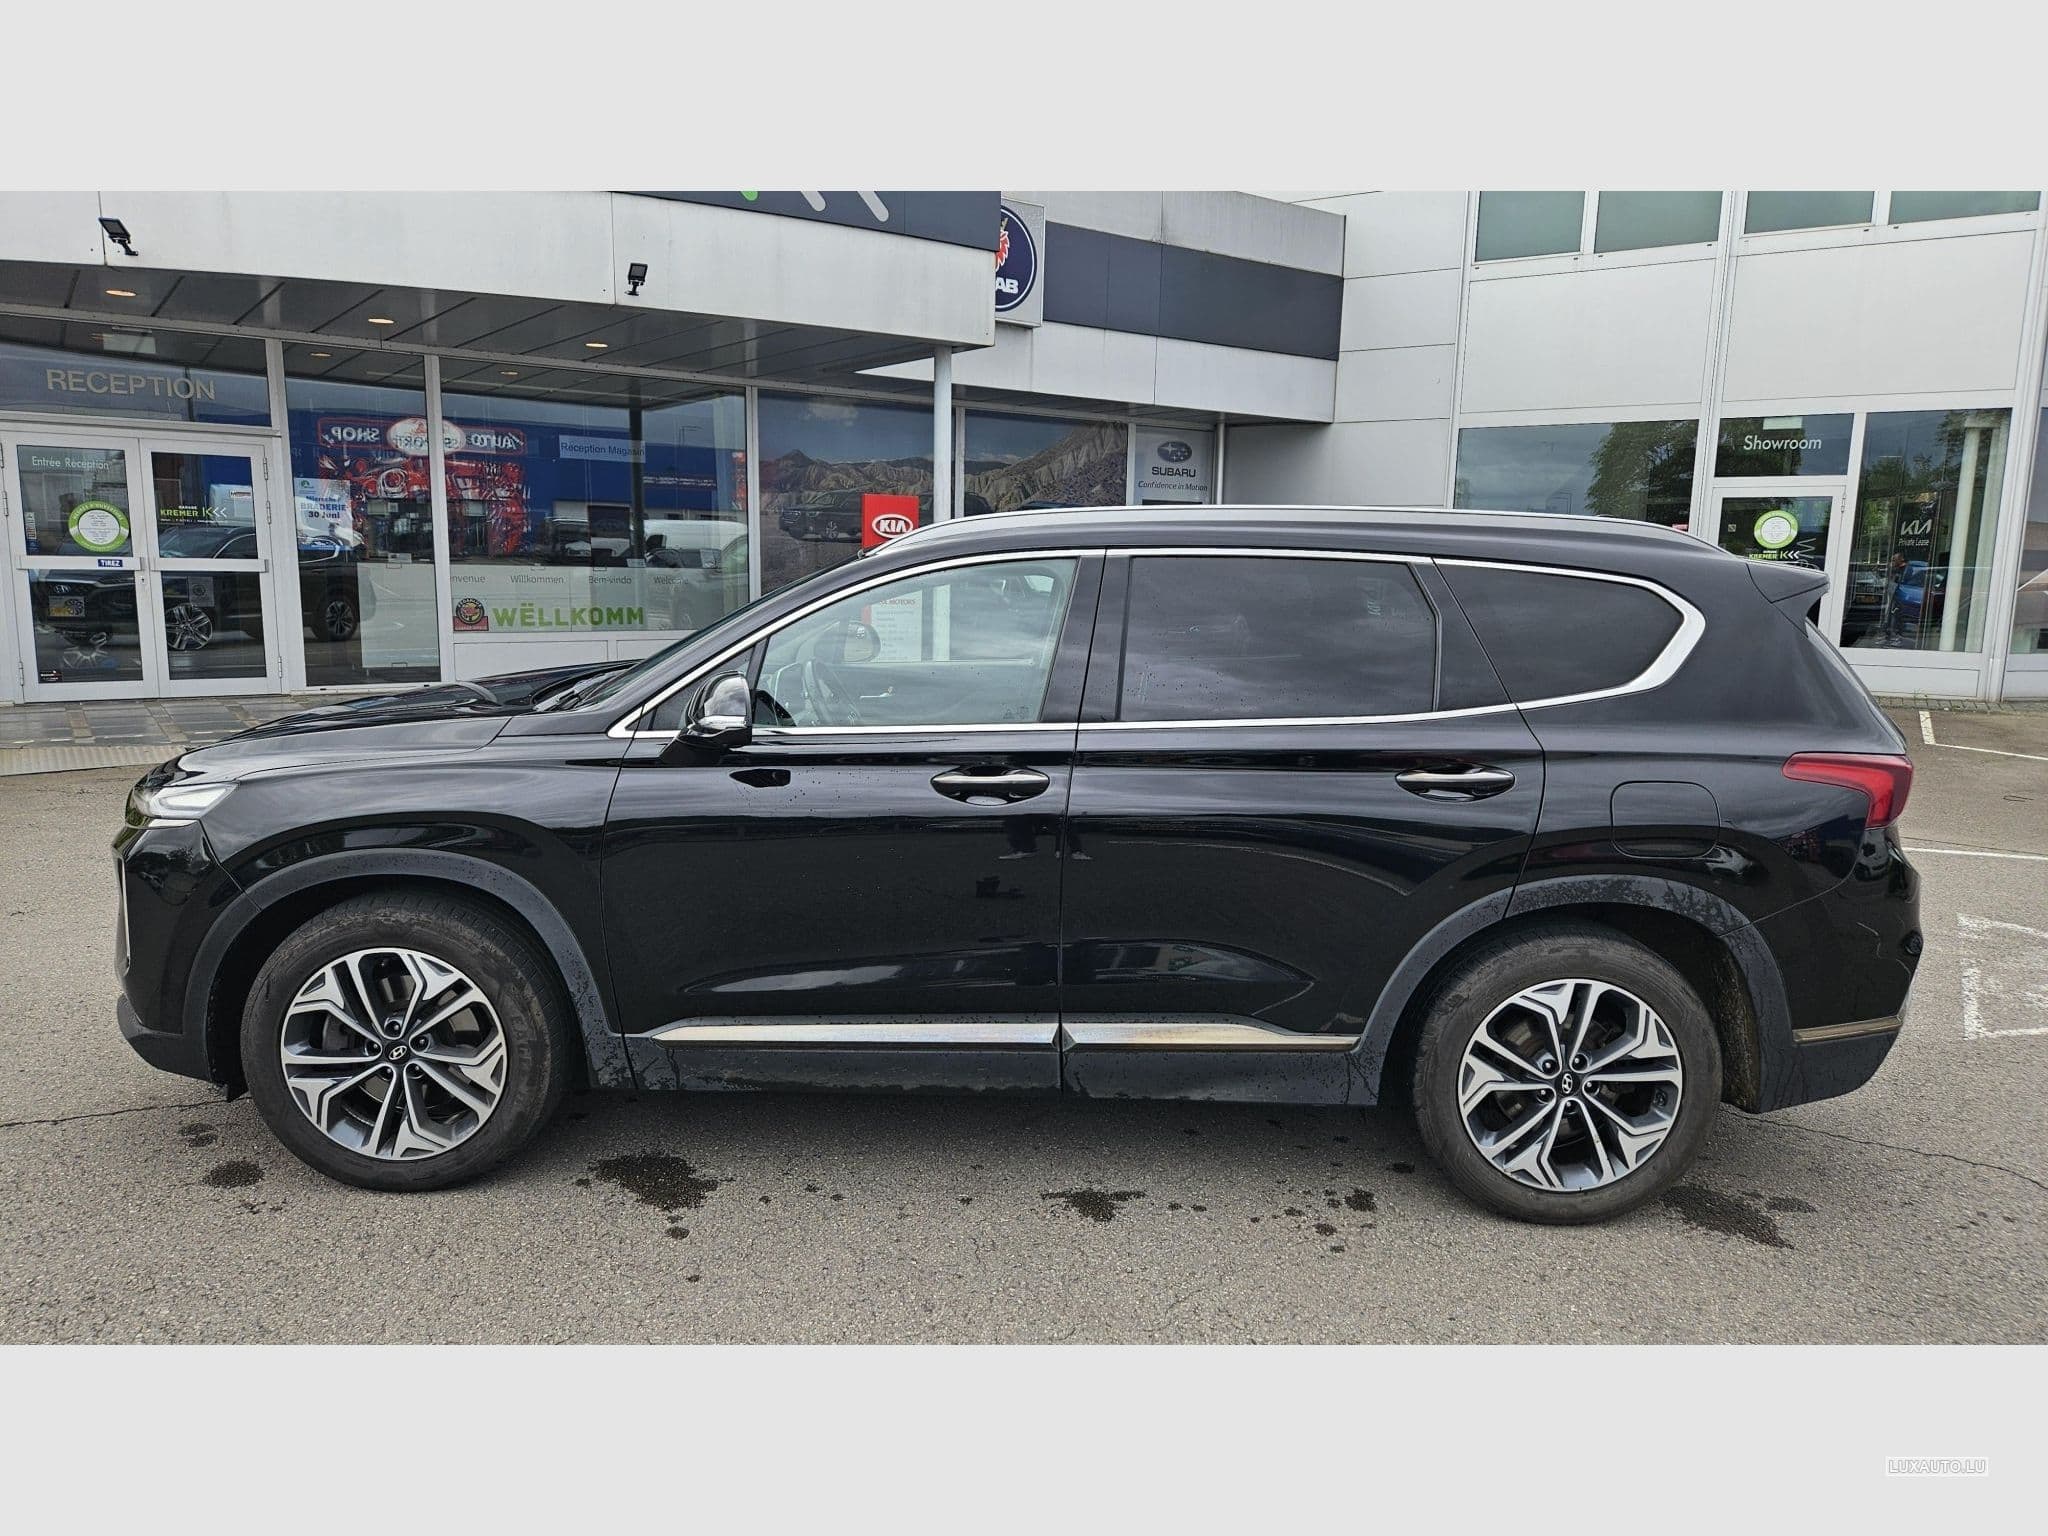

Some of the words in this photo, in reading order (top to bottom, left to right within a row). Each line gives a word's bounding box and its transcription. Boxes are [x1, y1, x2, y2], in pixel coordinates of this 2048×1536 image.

[995, 276, 1019, 294] AB
[46, 368, 216, 400] RECEPTION
[1743, 435, 1822, 451] Showroom
[1151, 466, 1196, 478] SUBARU
[1138, 480, 1176, 490] Confidence
[1177, 482, 1184, 490] in
[1185, 482, 1208, 491] Motion
[160, 509, 199, 517] KREMER
[880, 519, 907, 533] KIA
[510, 574, 564, 584] Willkommen
[588, 575, 632, 584] Bem-vindo
[491, 602, 643, 626] WËLLKOMM
